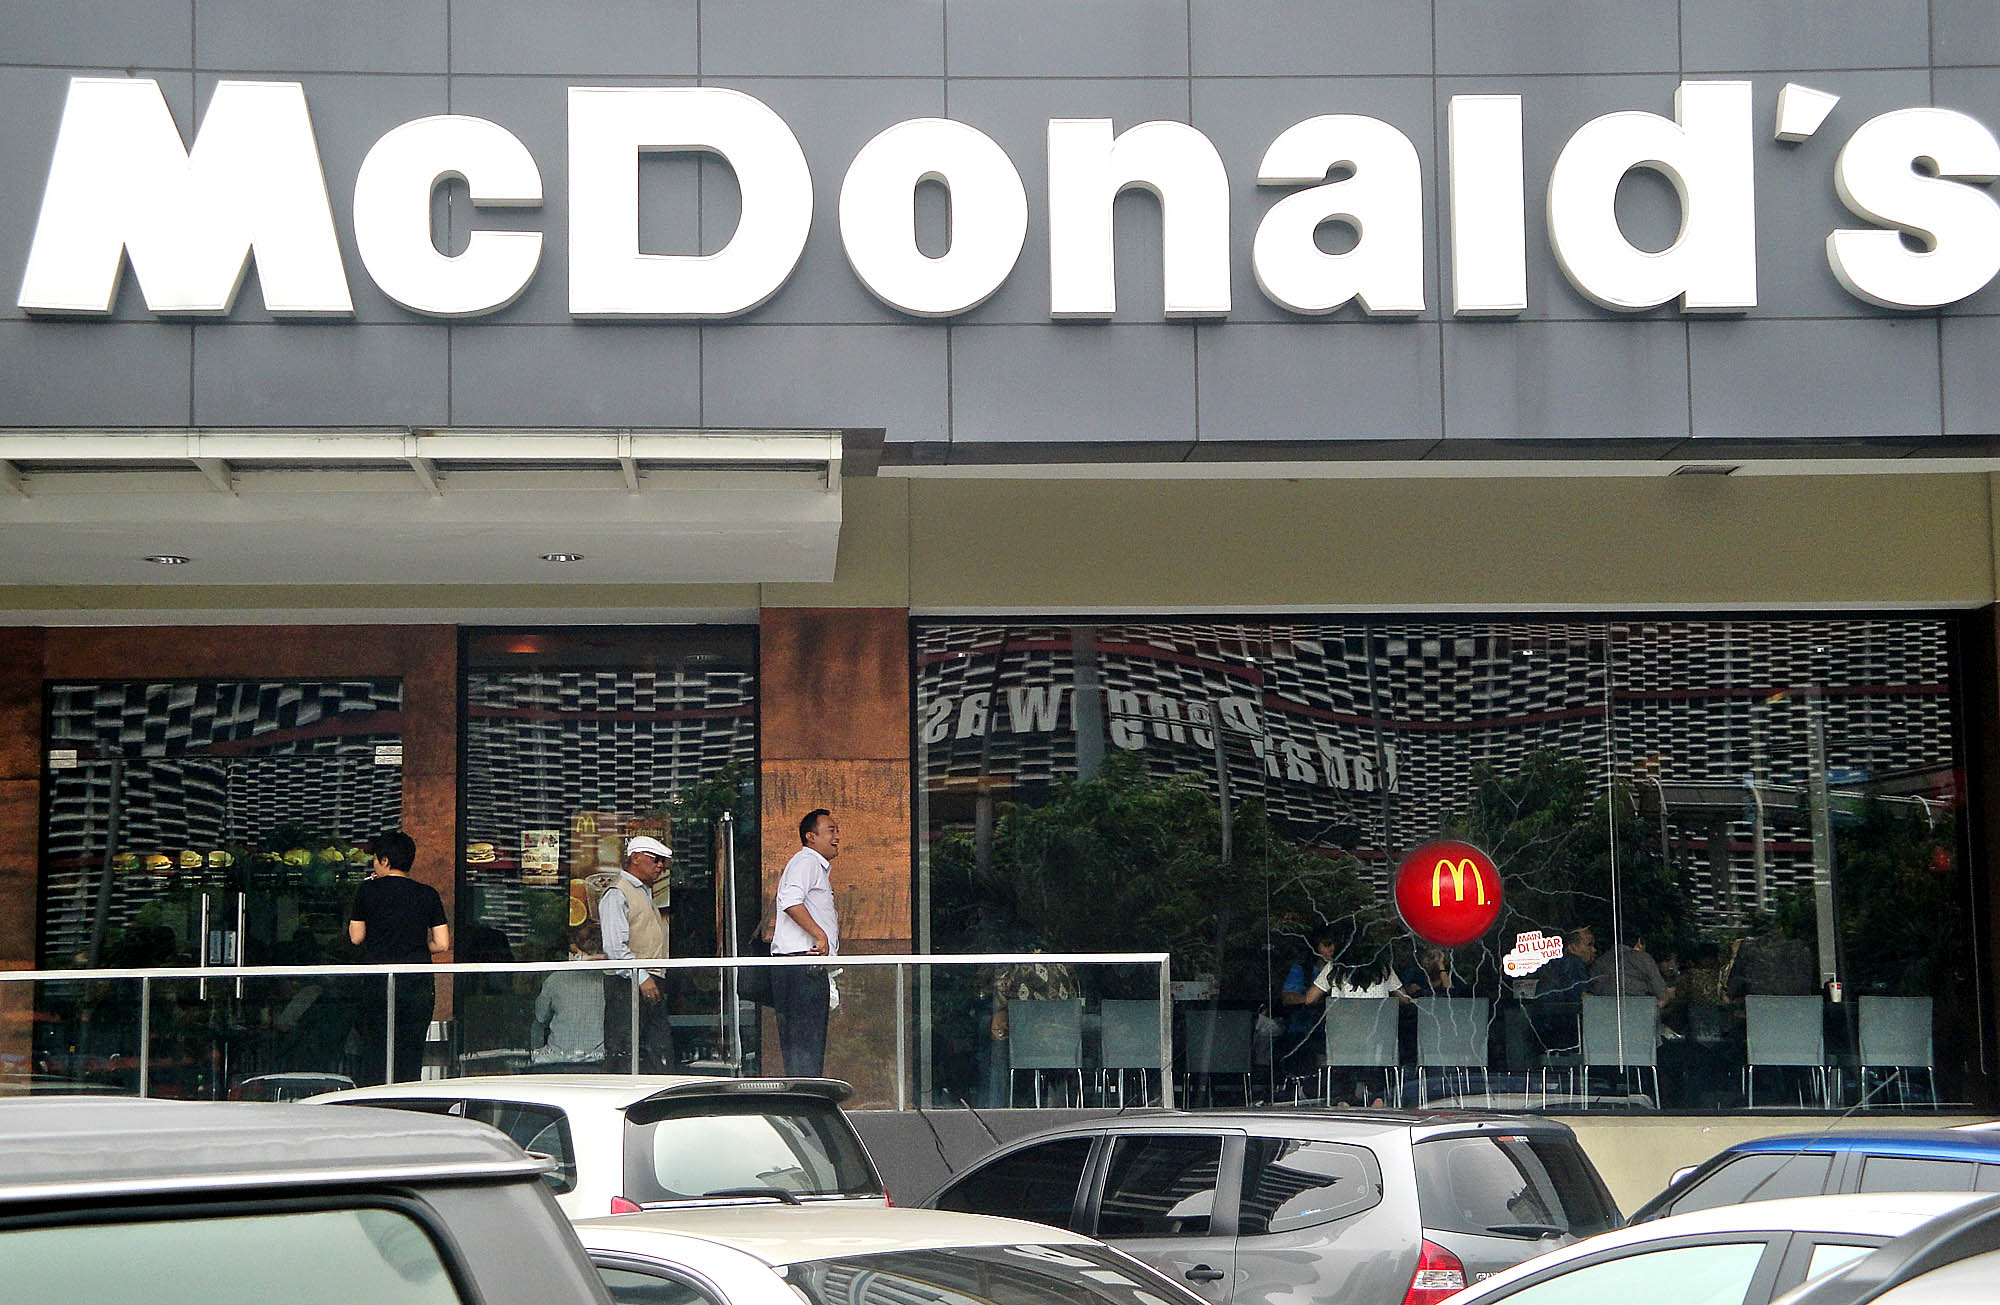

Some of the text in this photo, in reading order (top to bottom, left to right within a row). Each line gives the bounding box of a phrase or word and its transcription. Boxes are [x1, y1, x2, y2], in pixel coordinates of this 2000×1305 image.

[17, 77, 2000, 318] McDonald's
[1518, 932, 1541, 943] MAIN
[1517, 938, 1561, 954] DI LUAR
[1541, 948, 1561, 958] YUK!
